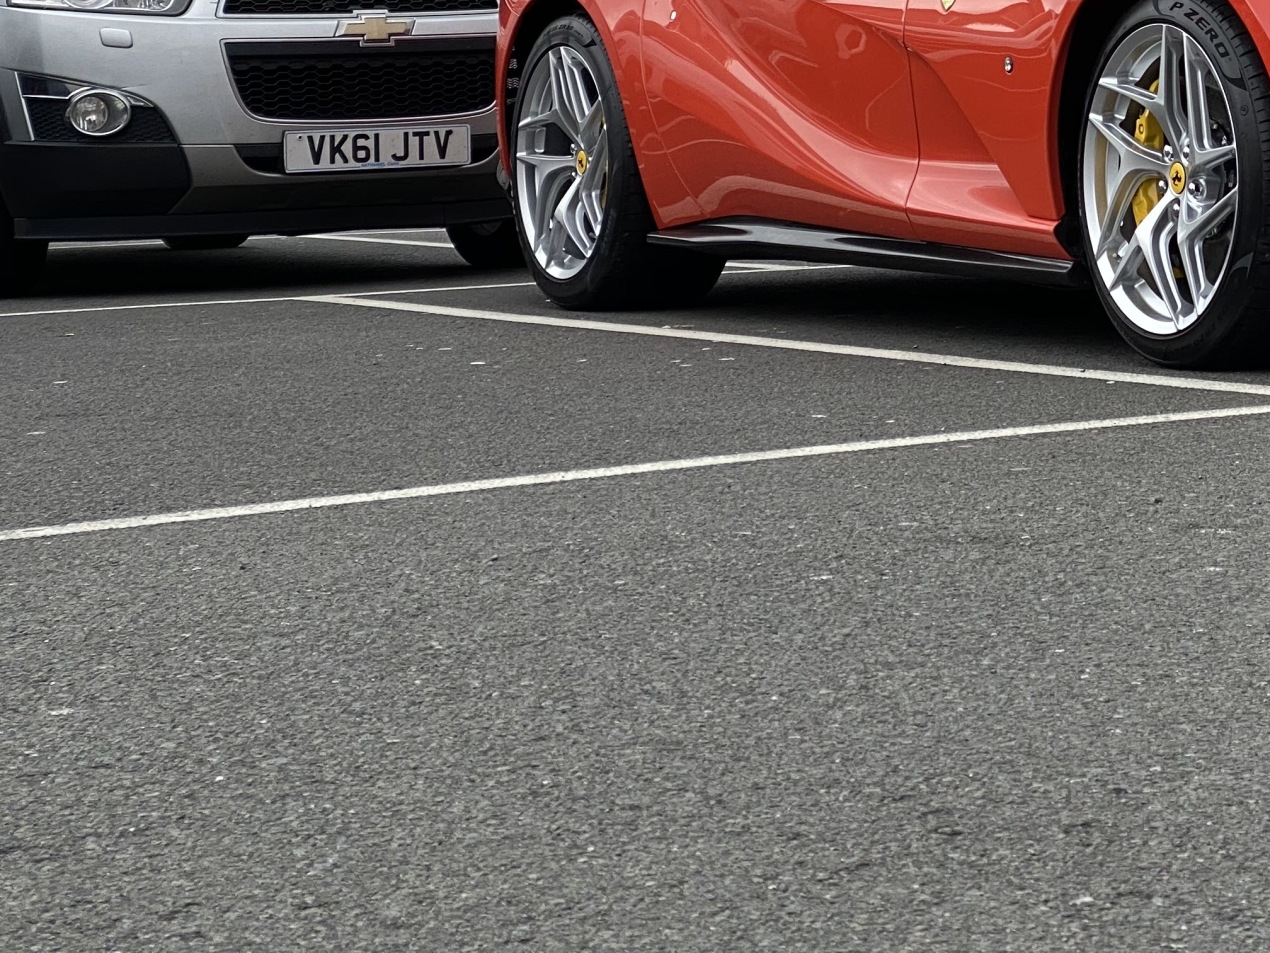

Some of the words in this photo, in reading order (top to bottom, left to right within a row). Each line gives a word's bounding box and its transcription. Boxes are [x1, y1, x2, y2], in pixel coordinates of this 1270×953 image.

[1169, 1, 1184, 11] P
[1183, 8, 1230, 58] ZERO
[307, 132, 380, 165] VK61
[390, 129, 453, 162] JTV
